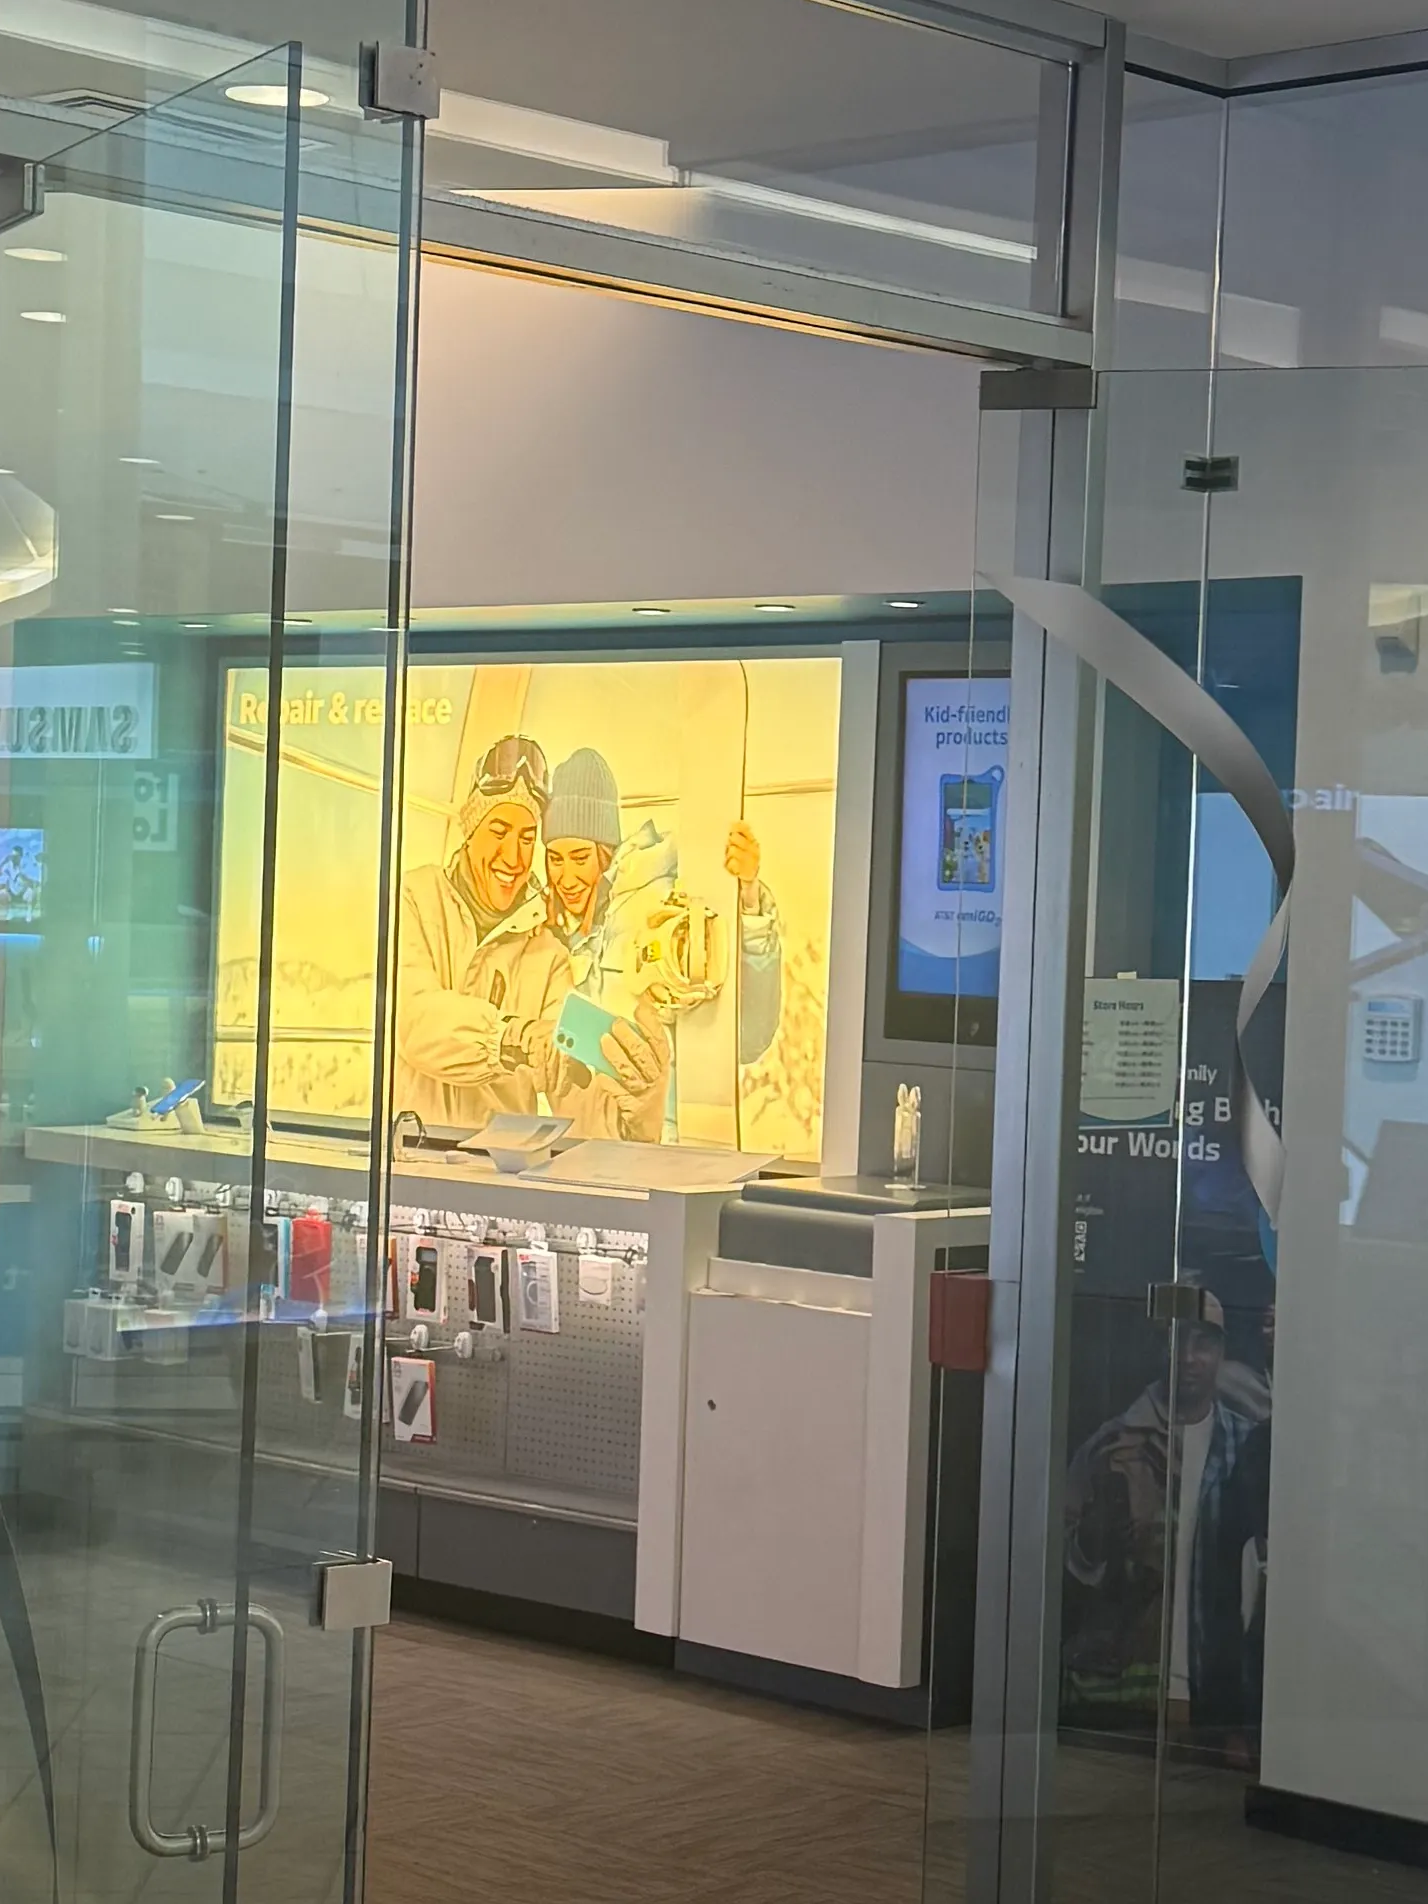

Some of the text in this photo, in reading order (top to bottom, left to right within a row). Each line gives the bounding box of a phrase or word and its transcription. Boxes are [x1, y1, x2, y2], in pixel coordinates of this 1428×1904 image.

[328, 692, 349, 725] &
[354, 696, 453, 725] reace
[924, 705, 1010, 724] Kid-friendl
[1078, 1131, 1221, 1162] our Wods
